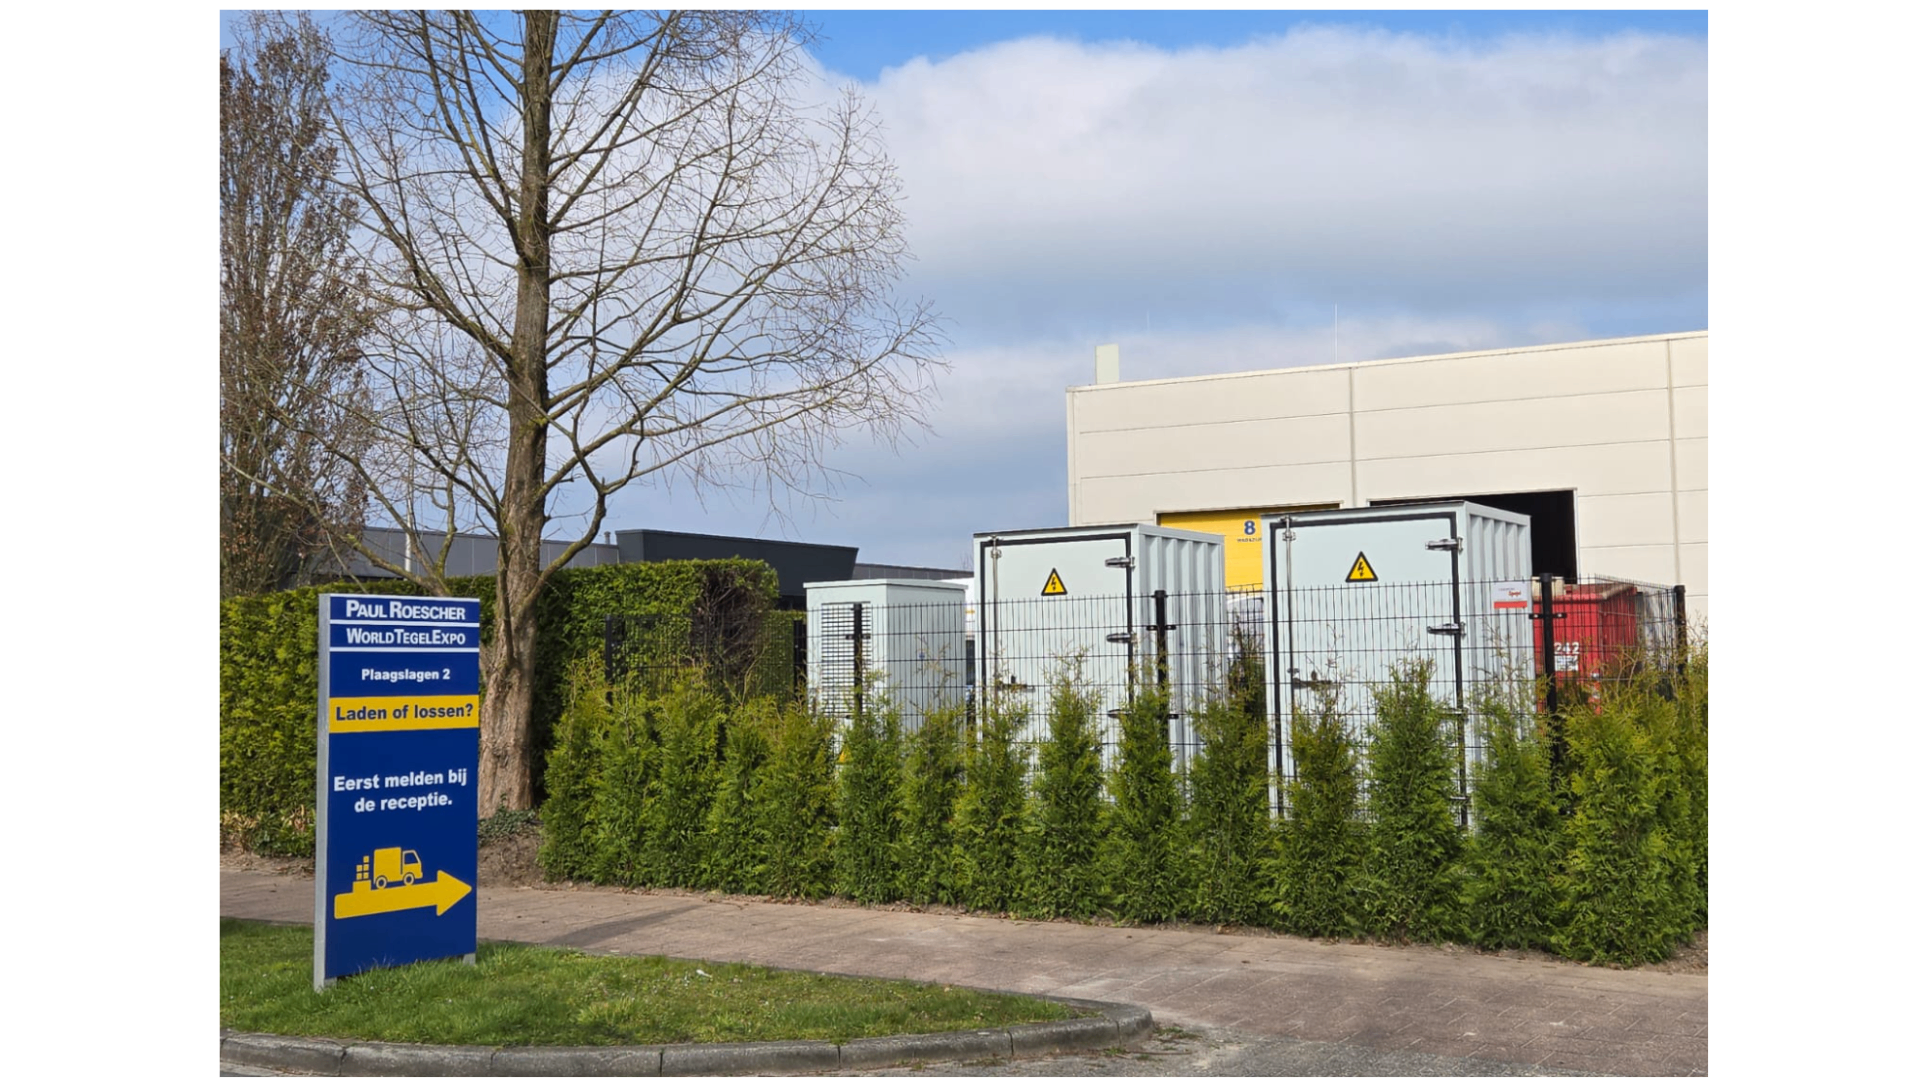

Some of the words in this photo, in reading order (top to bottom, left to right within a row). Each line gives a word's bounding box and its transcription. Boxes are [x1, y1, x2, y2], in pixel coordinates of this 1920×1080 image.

[1244, 520, 1256, 535] 8
[346, 599, 388, 618] PAUL
[389, 601, 466, 620] ROESCHER
[361, 668, 440, 683] Plaagslagen
[442, 668, 451, 680] 2
[336, 706, 387, 721] Laden
[392, 704, 409, 719] of
[414, 703, 473, 719] lossen?
[333, 774, 380, 792] Eerst
[384, 770, 444, 788] melden
[448, 767, 467, 787] bij
[354, 797, 376, 813] de
[380, 791, 453, 812] receptie.
